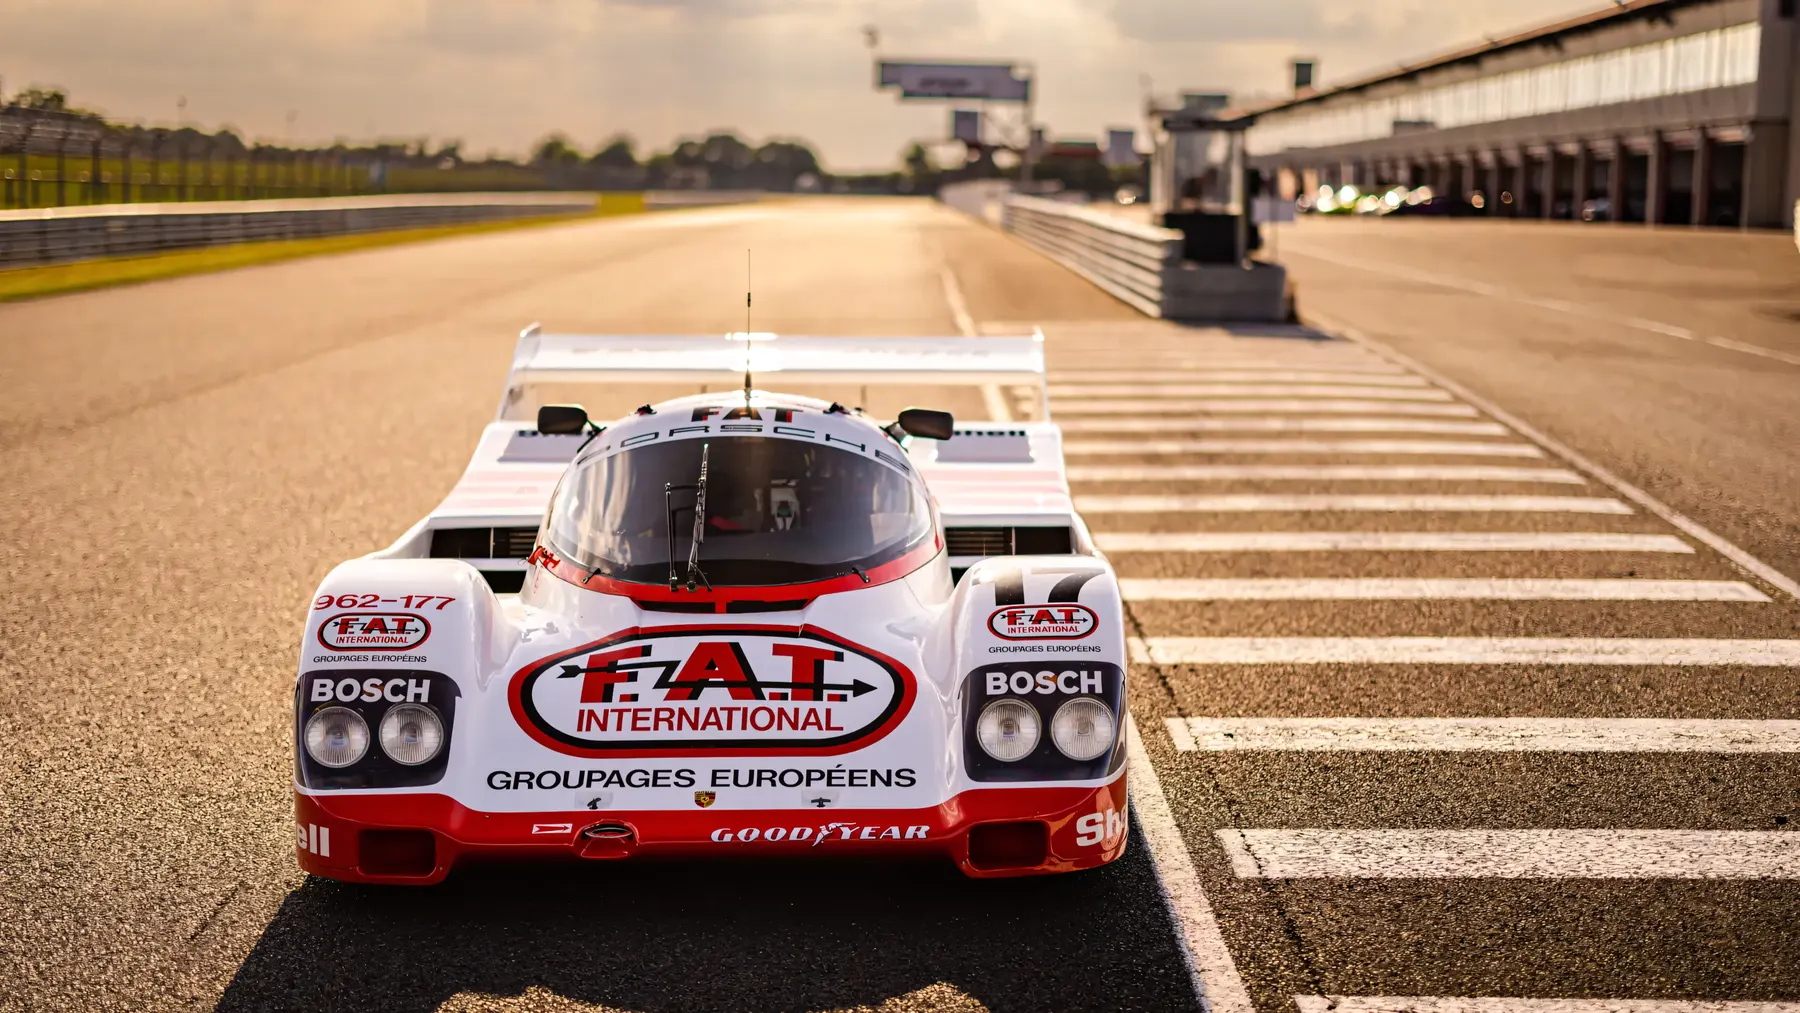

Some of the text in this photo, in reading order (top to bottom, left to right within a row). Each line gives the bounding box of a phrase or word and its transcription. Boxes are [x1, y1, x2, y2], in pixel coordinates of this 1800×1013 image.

[972, 567, 1106, 606] 17
[313, 593, 456, 611] 962-177
[337, 617, 415, 635] F.A.T.
[1006, 608, 1081, 626] F.A.T.
[1007, 625, 1081, 634] INTERNATIONAL
[335, 636, 409, 644] INTERNATIONAL
[988, 644, 1102, 654] GROUPAGES EUROPÉENS
[313, 653, 427, 663] GROUPAGES EUROPÉENS
[580, 641, 848, 704] F.A.T.
[311, 677, 431, 703] BOSCH
[985, 670, 1103, 695] BOSCH
[576, 705, 844, 732] INTERNATIONAL
[486, 763, 917, 790] GROUPAGES EUROPÉENS
